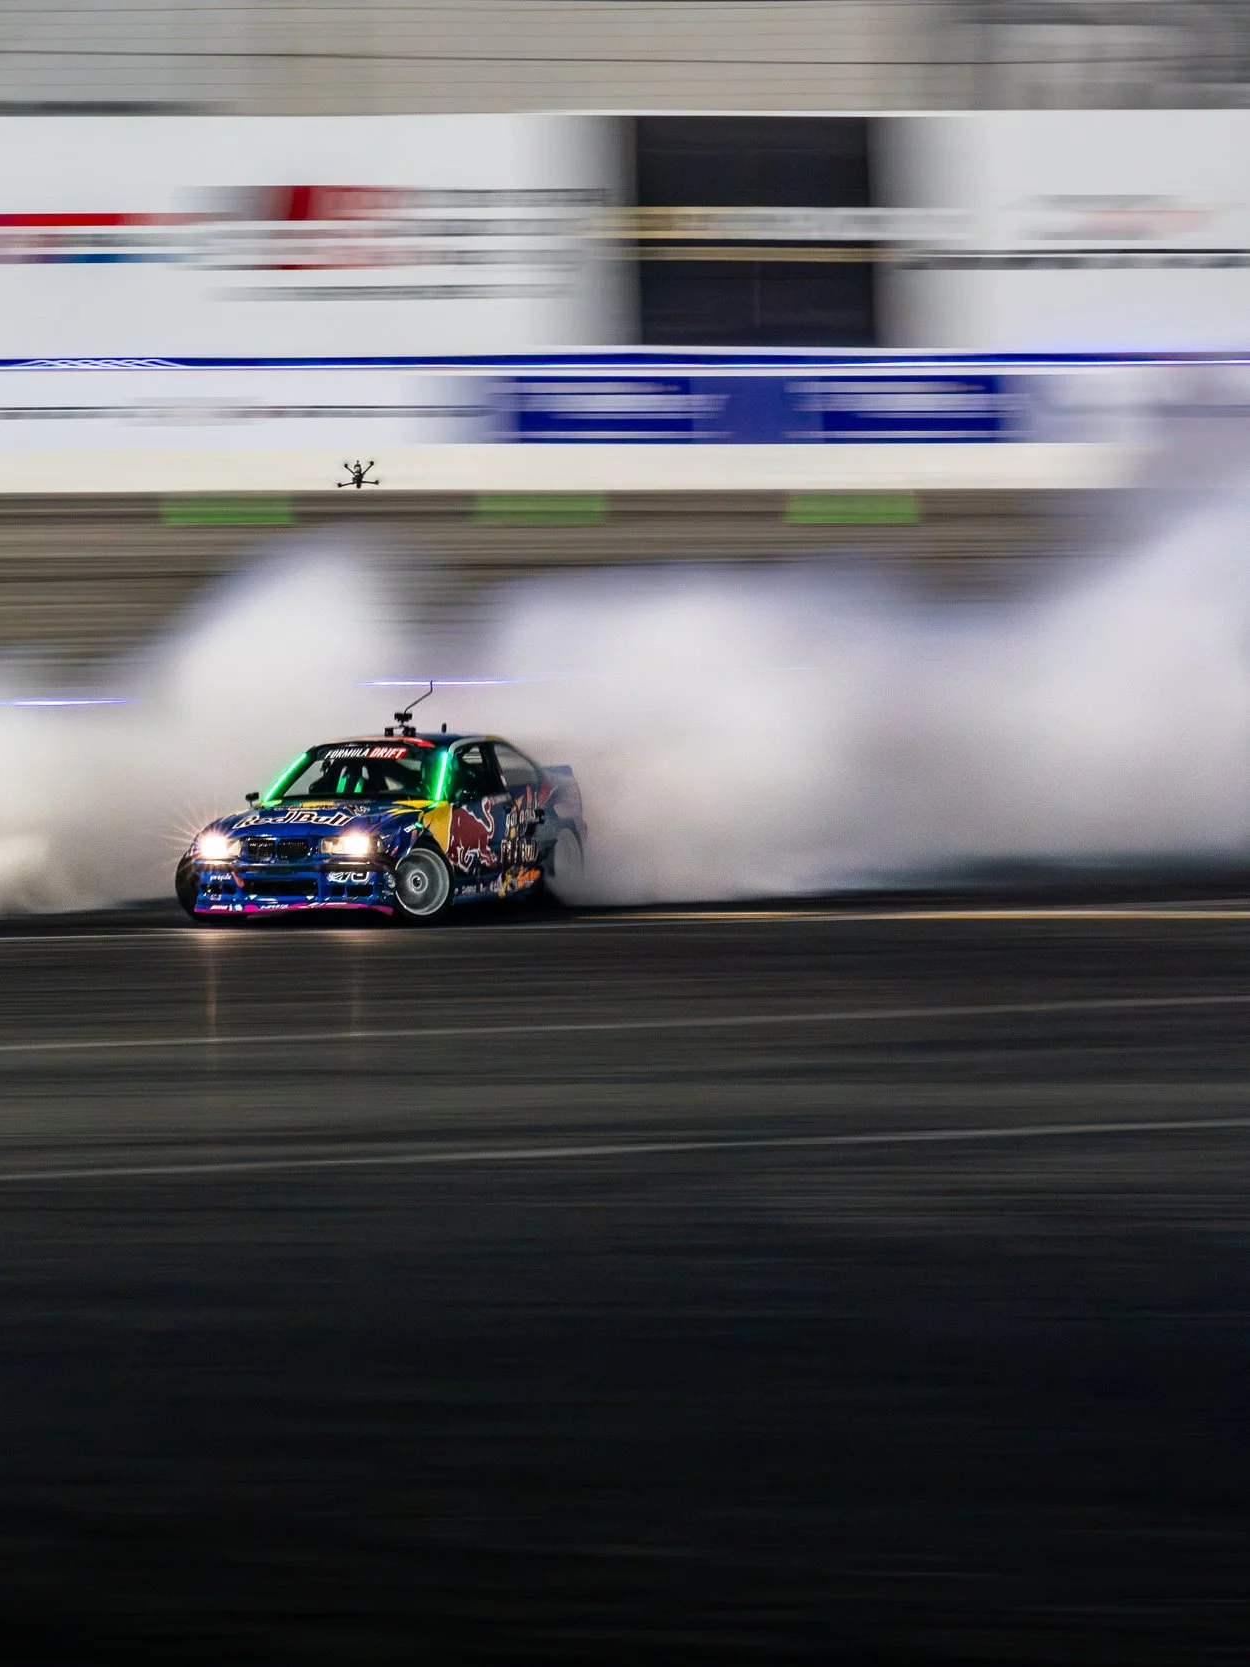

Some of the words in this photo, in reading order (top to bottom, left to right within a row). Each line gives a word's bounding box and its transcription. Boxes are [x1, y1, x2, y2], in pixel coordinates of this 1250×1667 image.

[324, 747, 370, 759] FORMULA
[368, 746, 406, 759] DRIFT
[232, 810, 295, 829] Red
[290, 811, 354, 827] Bull
